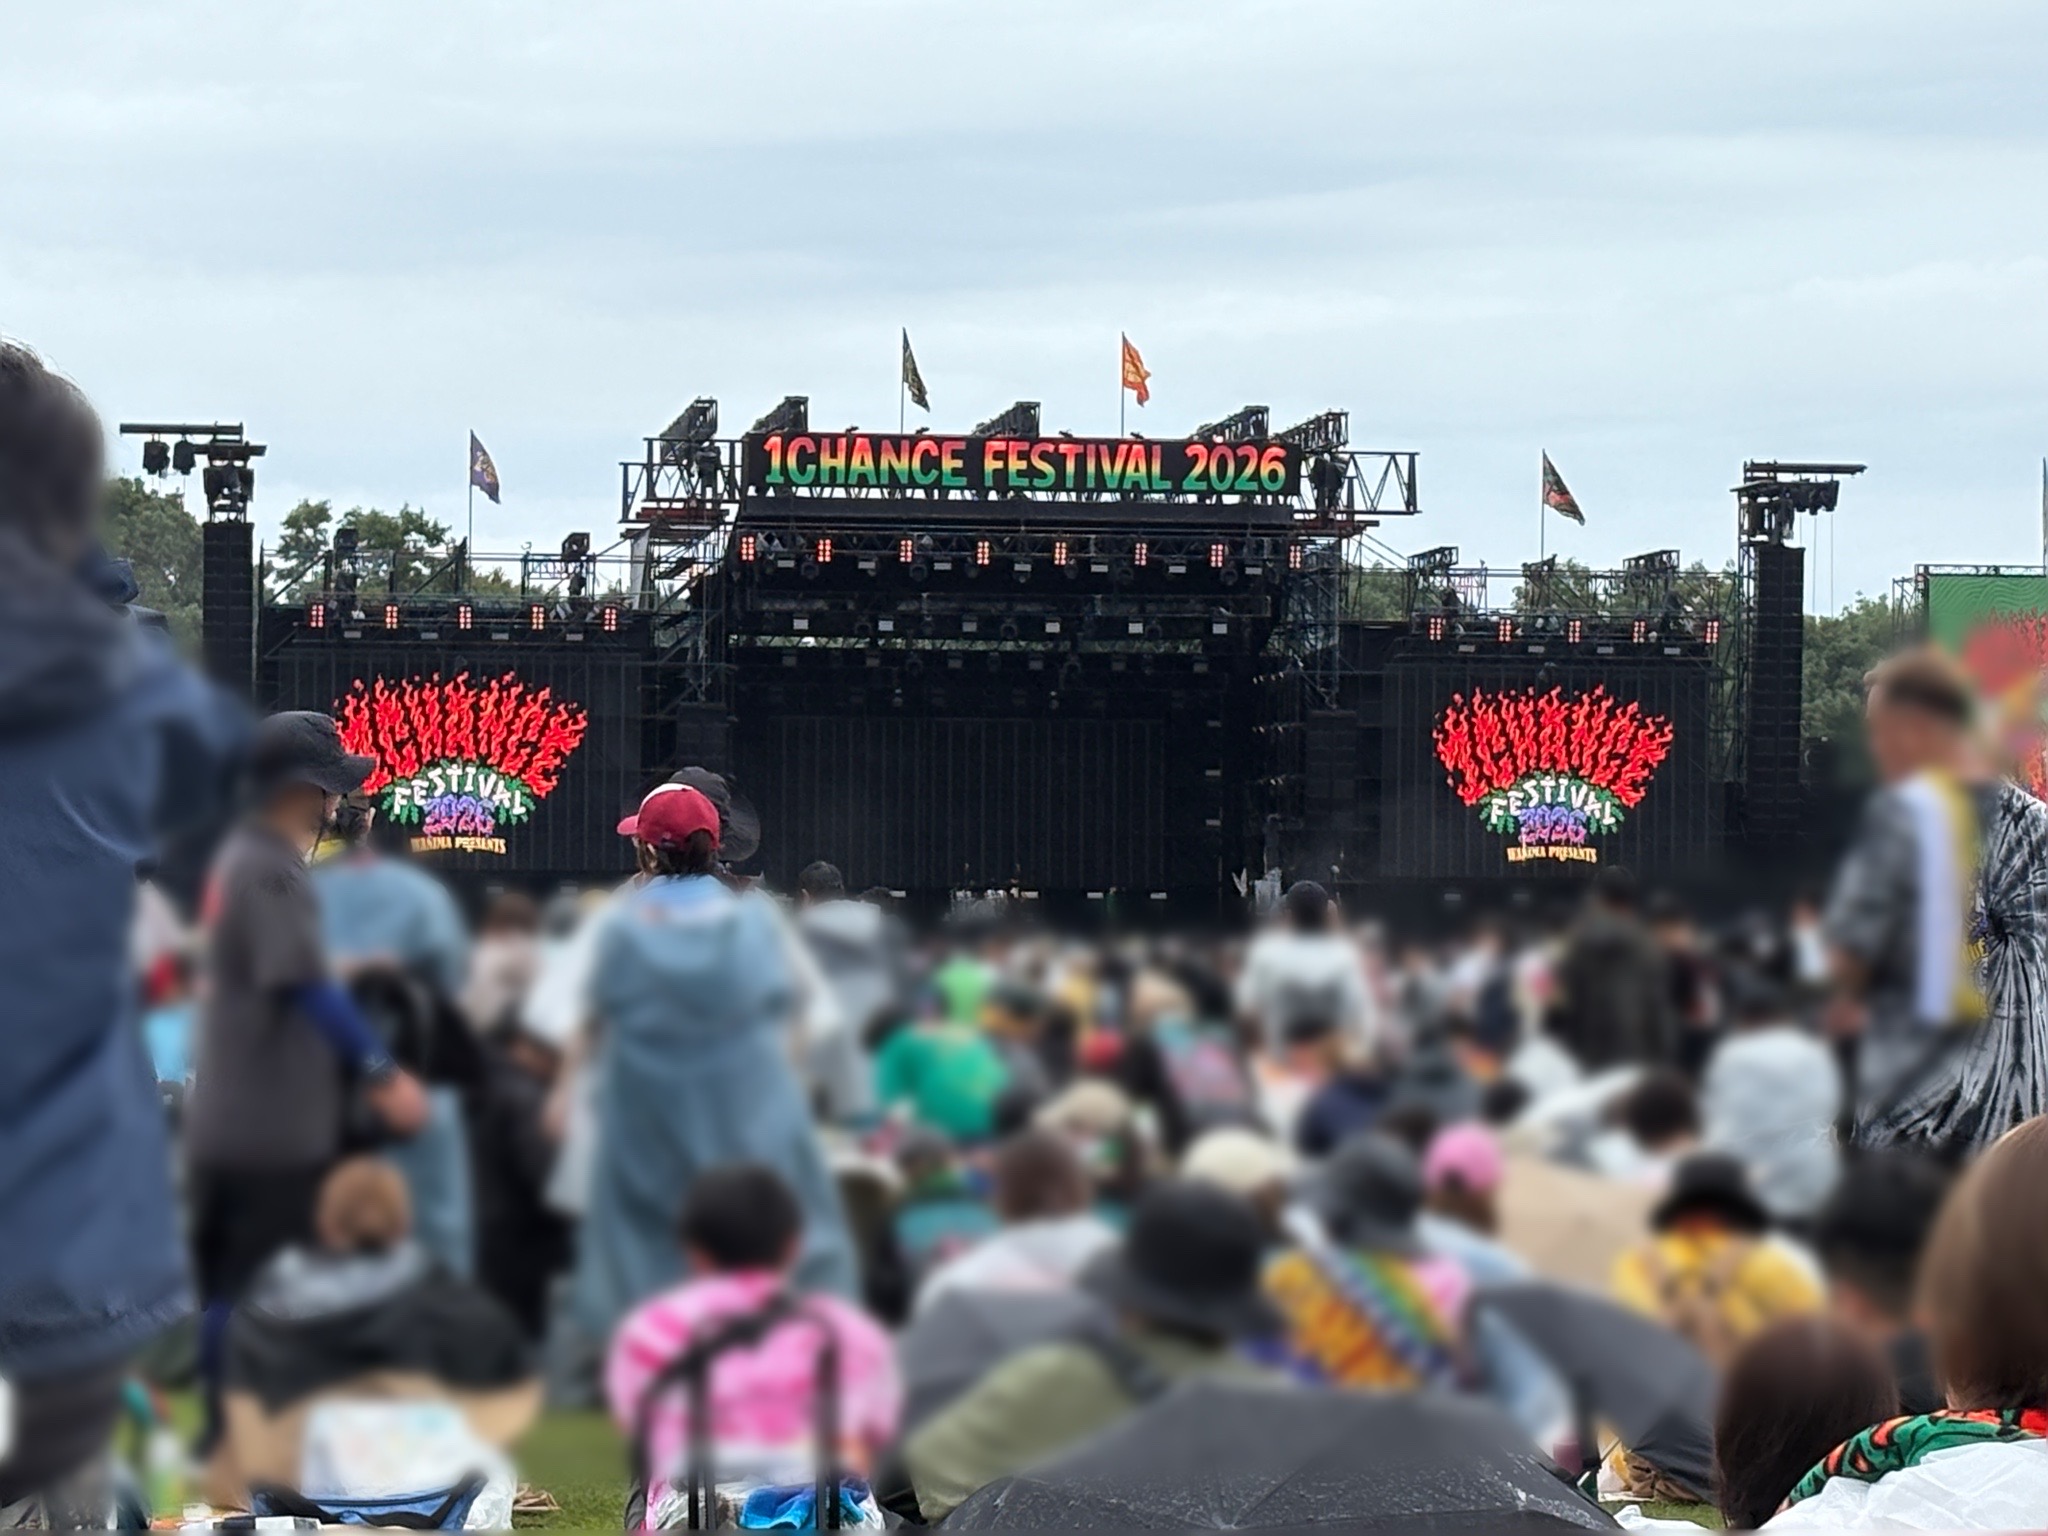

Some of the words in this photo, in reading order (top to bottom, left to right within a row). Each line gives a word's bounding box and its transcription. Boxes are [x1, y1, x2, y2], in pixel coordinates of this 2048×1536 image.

[763, 434, 967, 486] 1CHANCE
[983, 437, 1171, 490] FESTIVAL
[1182, 443, 1287, 491] 2026
[393, 763, 527, 814] FESTIVAL
[1490, 776, 1616, 825] FESTIVAL
